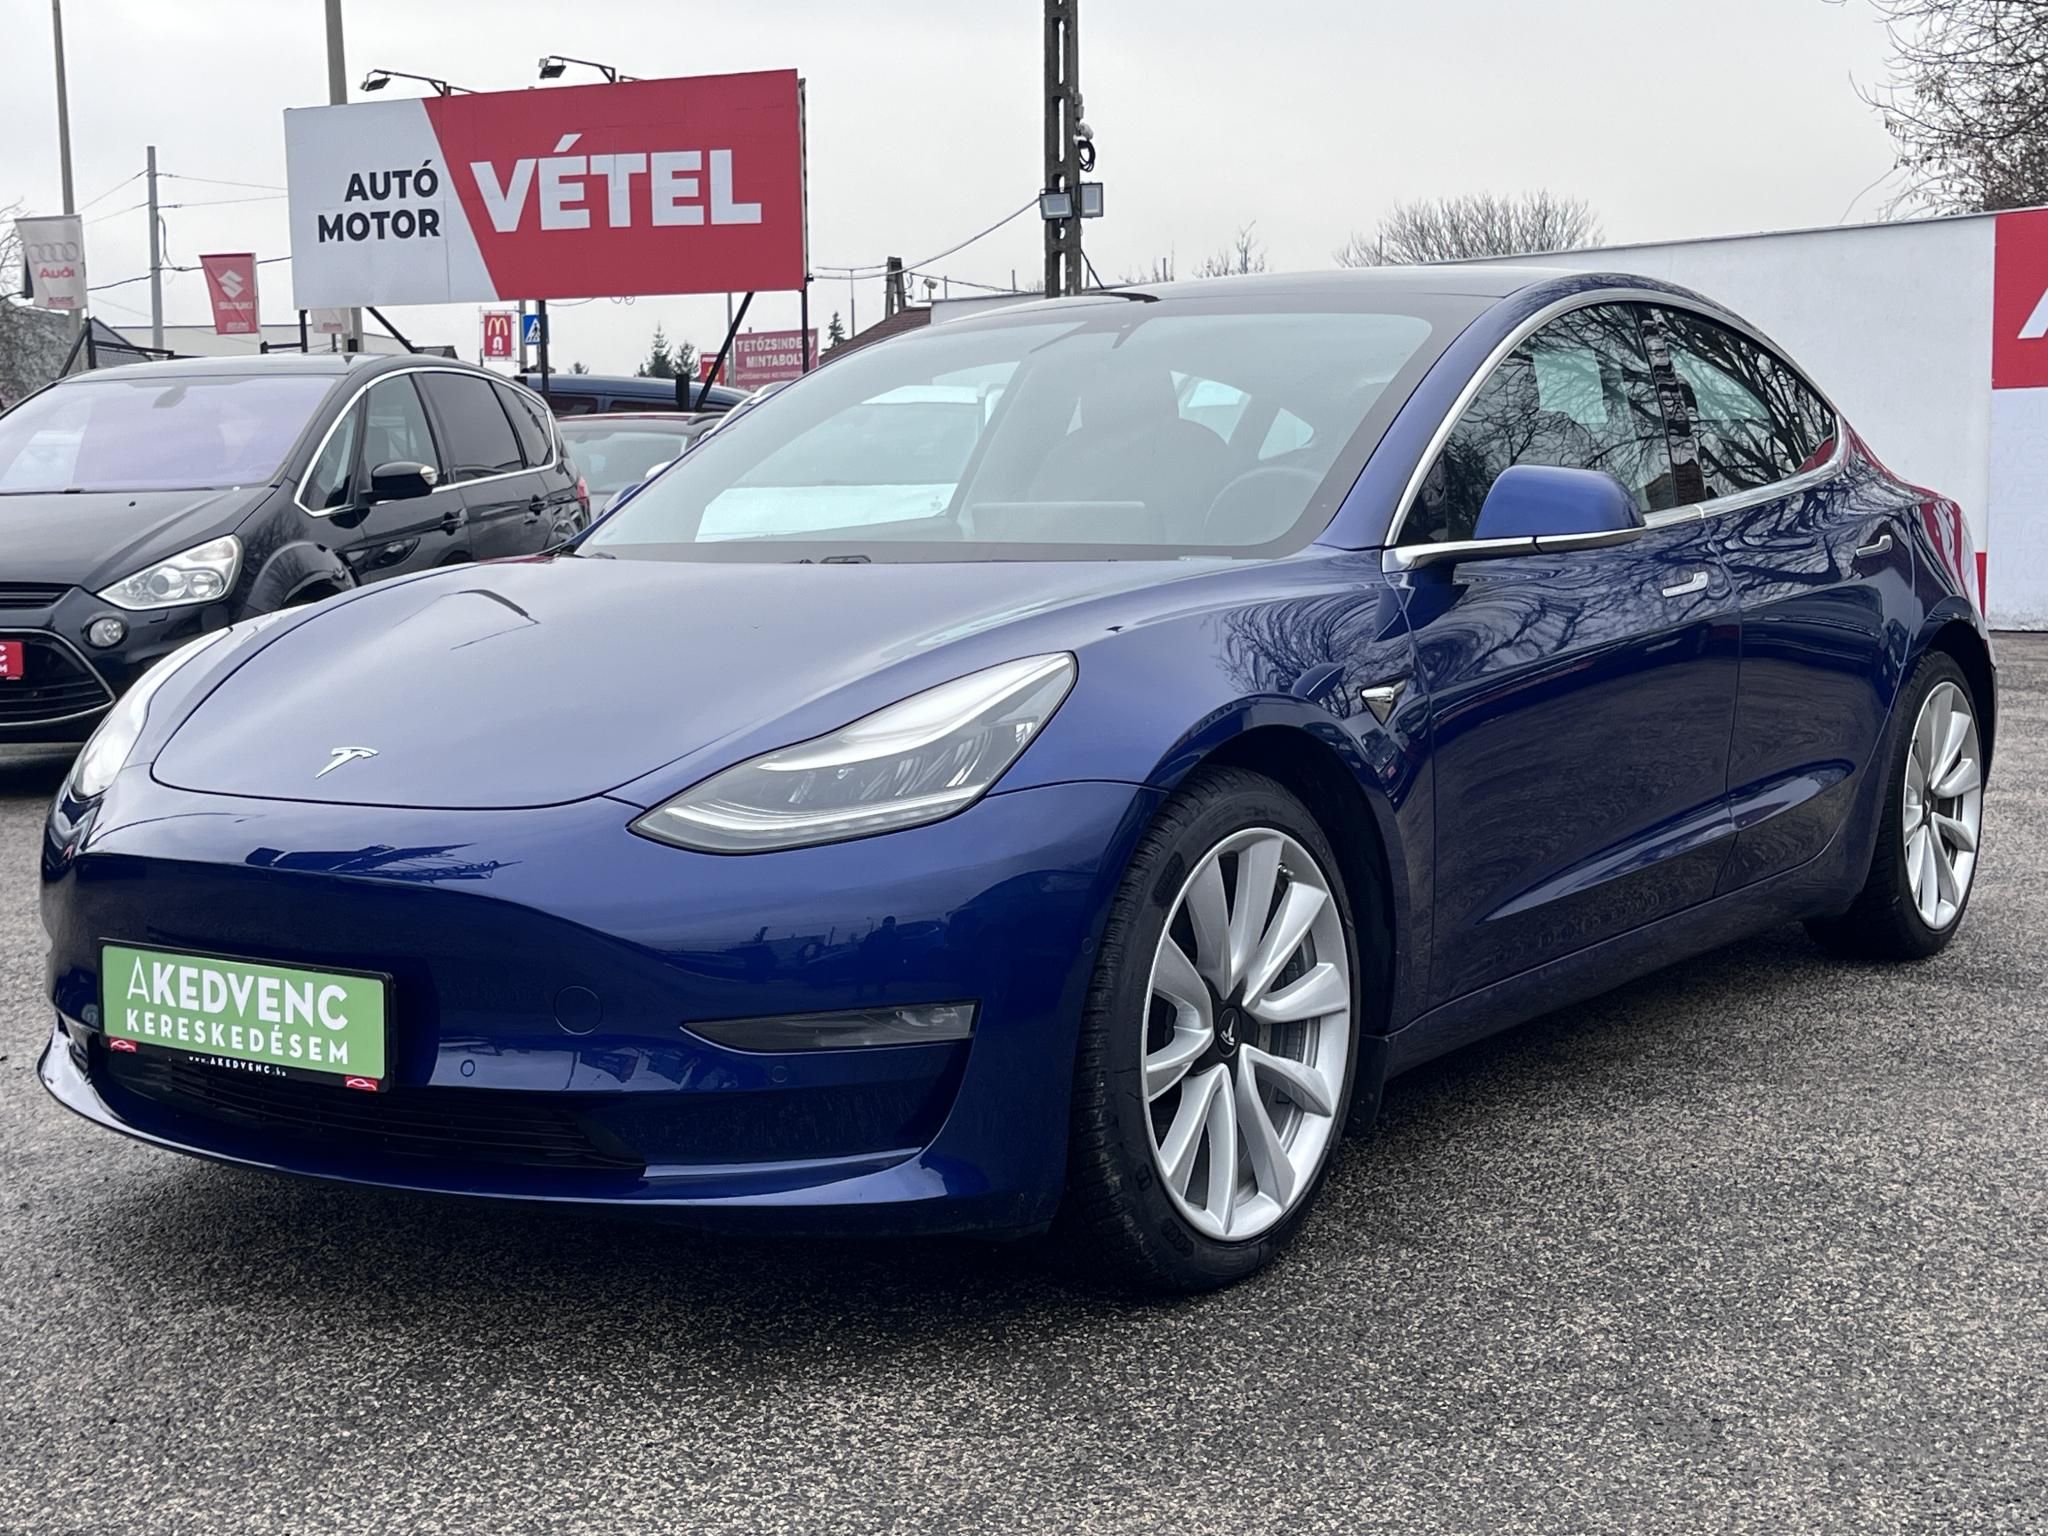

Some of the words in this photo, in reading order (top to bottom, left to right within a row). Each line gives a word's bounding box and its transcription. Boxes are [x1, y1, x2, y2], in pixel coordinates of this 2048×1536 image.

[344, 159, 439, 202] AUTÓ
[469, 133, 763, 233] VÉTEL
[318, 208, 441, 243] MOTOR
[736, 335, 816, 353] TETŐZSINDEY
[126, 1008, 349, 1065] KERESKEDÉSEM
